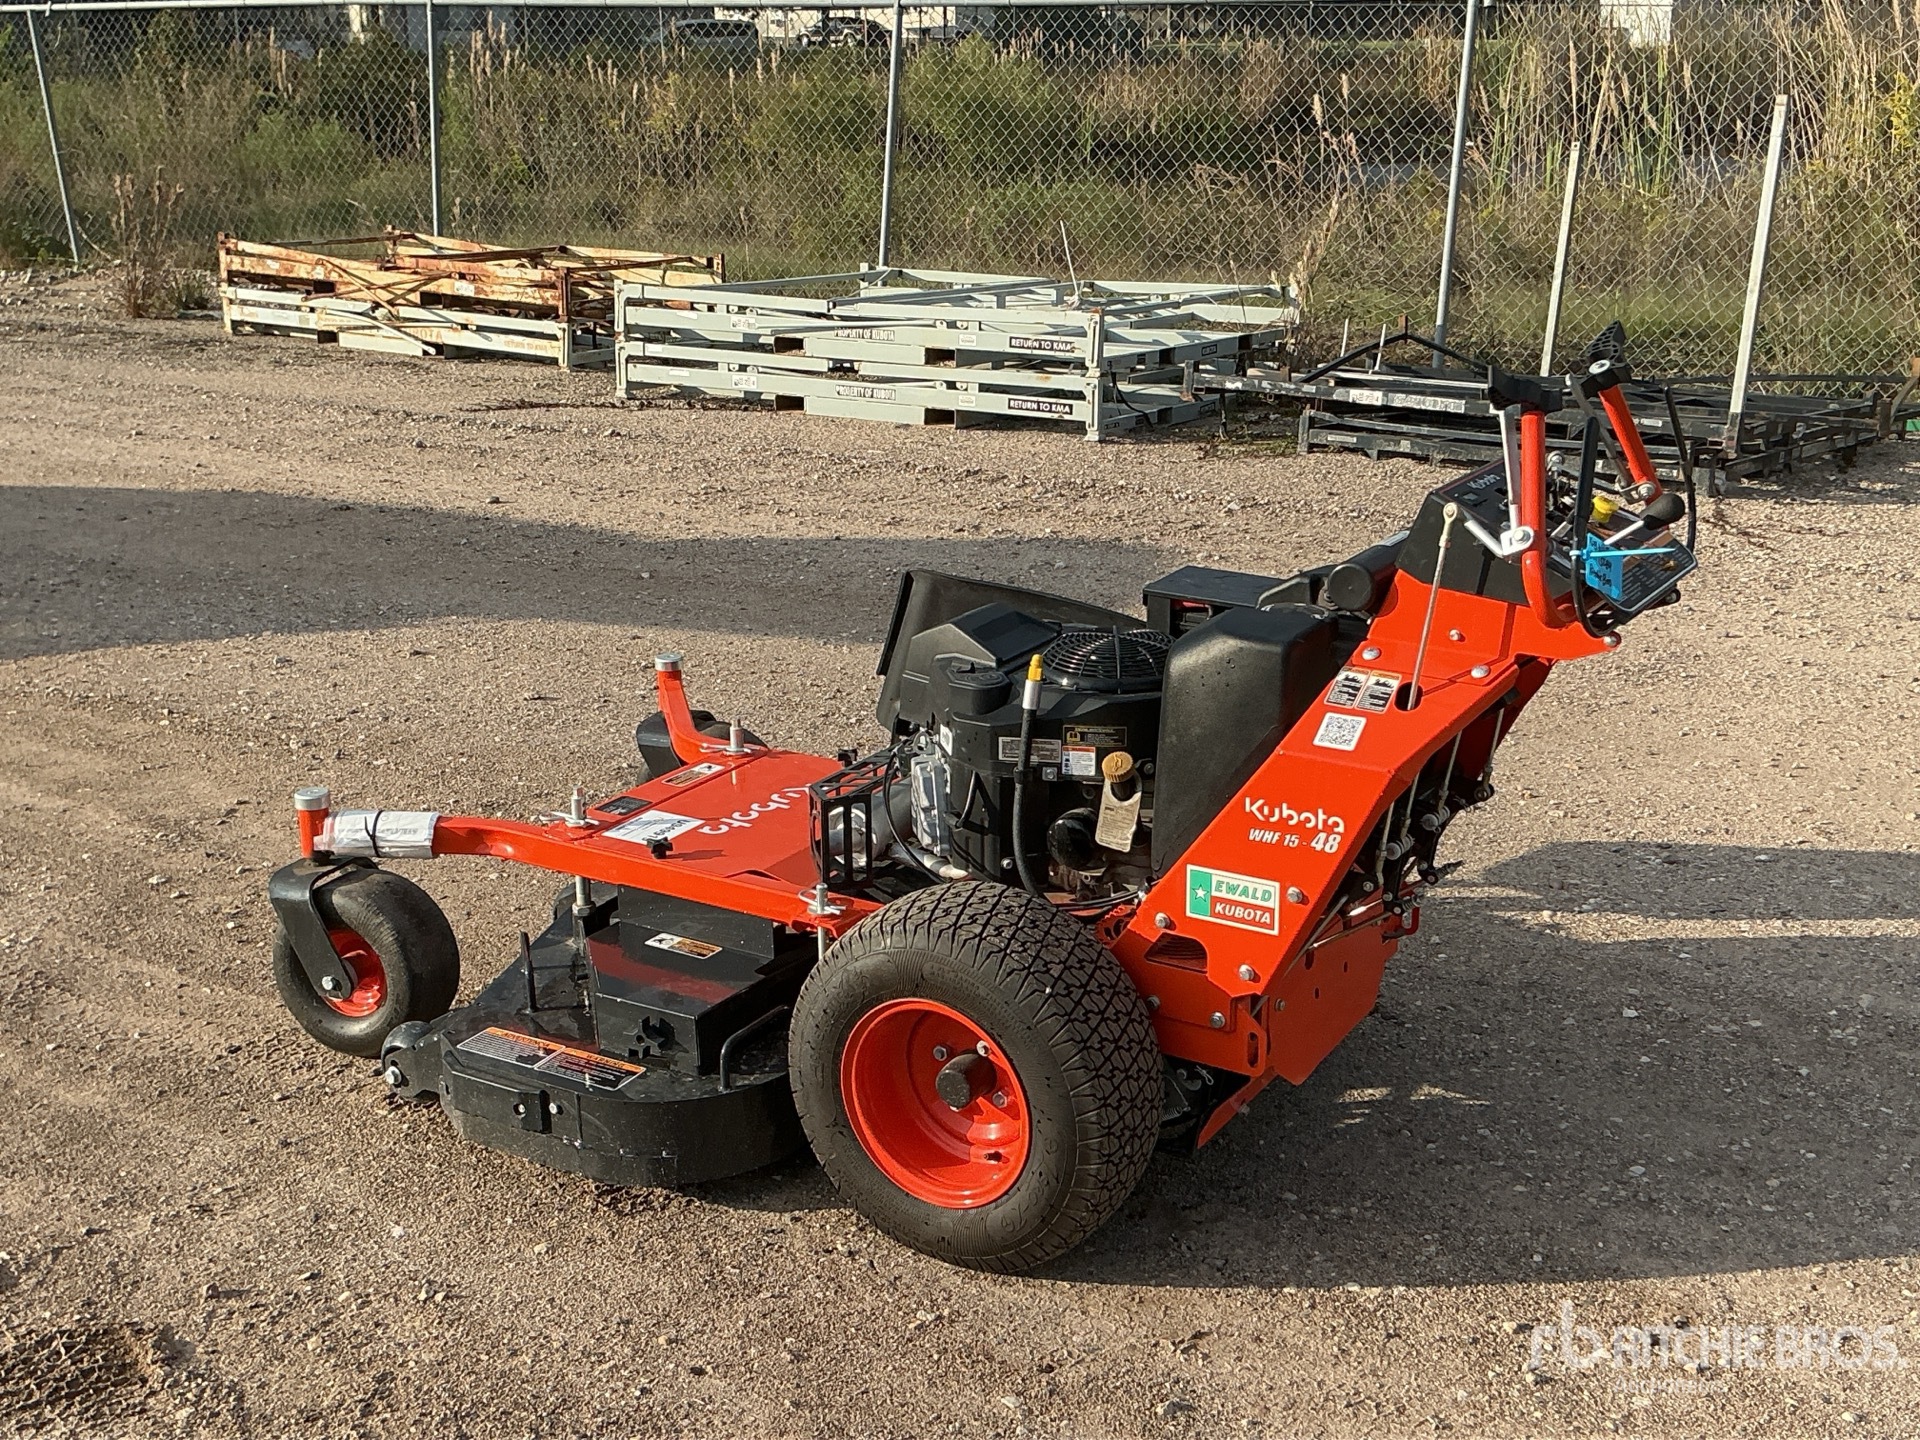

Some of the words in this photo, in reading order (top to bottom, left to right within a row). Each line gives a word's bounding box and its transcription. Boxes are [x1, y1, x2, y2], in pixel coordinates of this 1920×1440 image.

[864, 329, 871, 339] OF
[1011, 338, 1040, 350] RETURN
[1040, 340, 1052, 349] TO
[1053, 341, 1071, 352] KMA
[865, 387, 872, 398] OF
[1009, 400, 1037, 410] RETURN
[1039, 402, 1050, 411] TO
[1051, 403, 1071, 413] KMA
[1244, 796, 1345, 833] Kubota
[1248, 828, 1281, 845] WHF
[1283, 834, 1300, 848] 15
[1310, 832, 1341, 853] 48
[1214, 879, 1273, 902] EWALD
[1214, 902, 1271, 925] KUBOTA
[586, 1053, 625, 1068] WARNING
